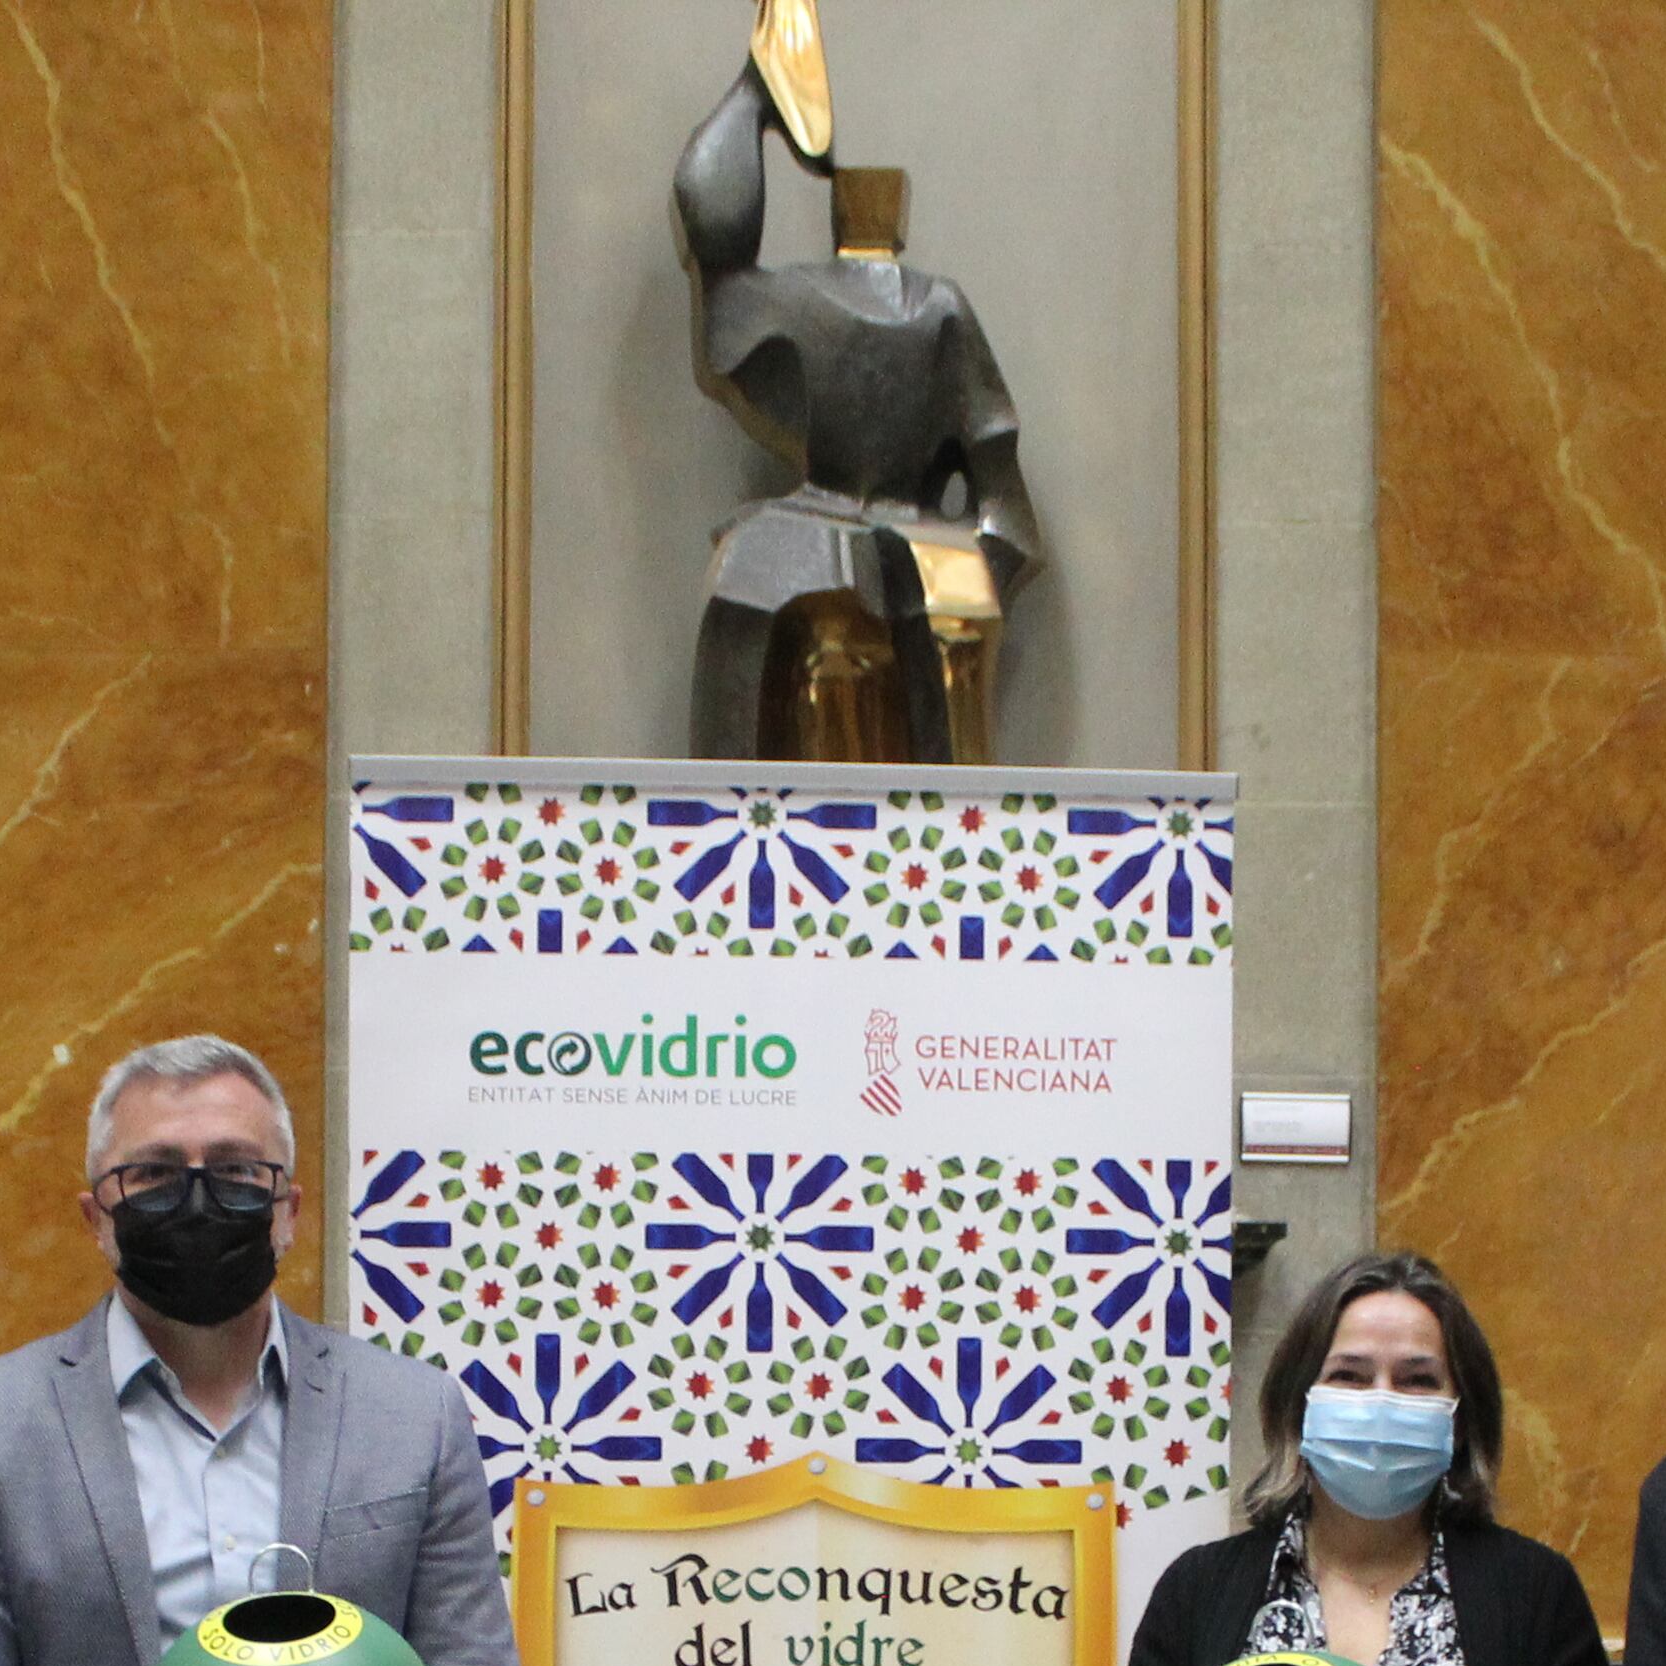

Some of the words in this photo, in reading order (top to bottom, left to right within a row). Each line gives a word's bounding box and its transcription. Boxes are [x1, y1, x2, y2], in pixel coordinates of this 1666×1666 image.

[469, 1013, 796, 1078] ecovidrio
[915, 1035, 1118, 1061] GENERALITAT
[468, 1086, 555, 1103] ENTITAT
[562, 1087, 628, 1104] SENSE
[635, 1084, 687, 1105] ÀNIM
[695, 1088, 720, 1105] DE
[729, 1089, 797, 1106] LUCRE
[916, 1067, 1112, 1093] VALENCIANA
[564, 1572, 637, 1618] La
[651, 1553, 1070, 1620] Reconquesta
[202, 1628, 254, 1661] SOLO
[269, 1625, 352, 1661] VIDRIO
